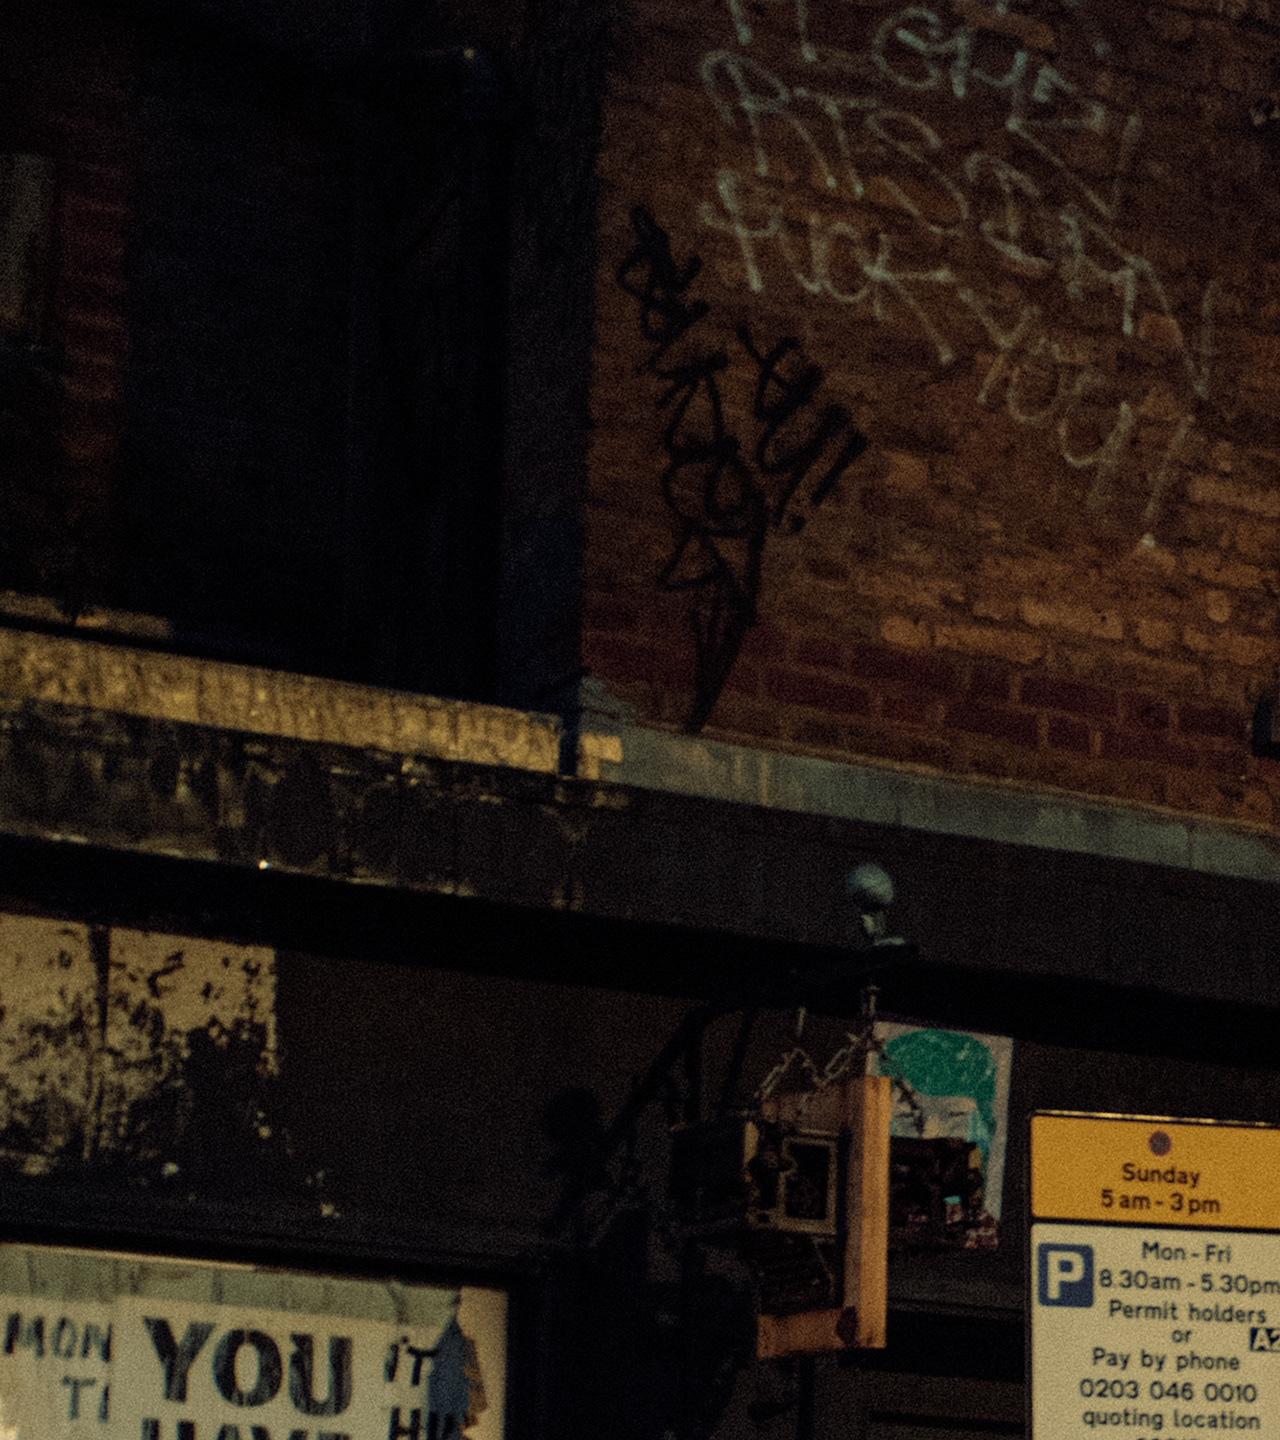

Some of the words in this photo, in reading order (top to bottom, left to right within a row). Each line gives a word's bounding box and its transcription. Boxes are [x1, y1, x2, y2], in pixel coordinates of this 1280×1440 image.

[1121, 1162, 1201, 1189] Sunday
[1141, 1240, 1186, 1262] Mon
[1205, 1243, 1233, 1264] Fri
[1046, 1250, 1086, 1302] P
[1099, 1268, 1182, 1292] 8.30am
[1108, 1298, 1178, 1322] Permit
[1188, 1301, 1268, 1325] holders
[1171, 1328, 1192, 1344] or
[142, 1316, 354, 1418] YOU
[1092, 1346, 1131, 1371] Pay
[1140, 1349, 1167, 1373] by
[1176, 1350, 1241, 1373] phone
[1078, 1377, 1140, 1400] 0203
[1149, 1380, 1195, 1402] 046
[1203, 1382, 1258, 1404] 0010
[1082, 1408, 1164, 1432] quoting
[1172, 1409, 1262, 1431] location
